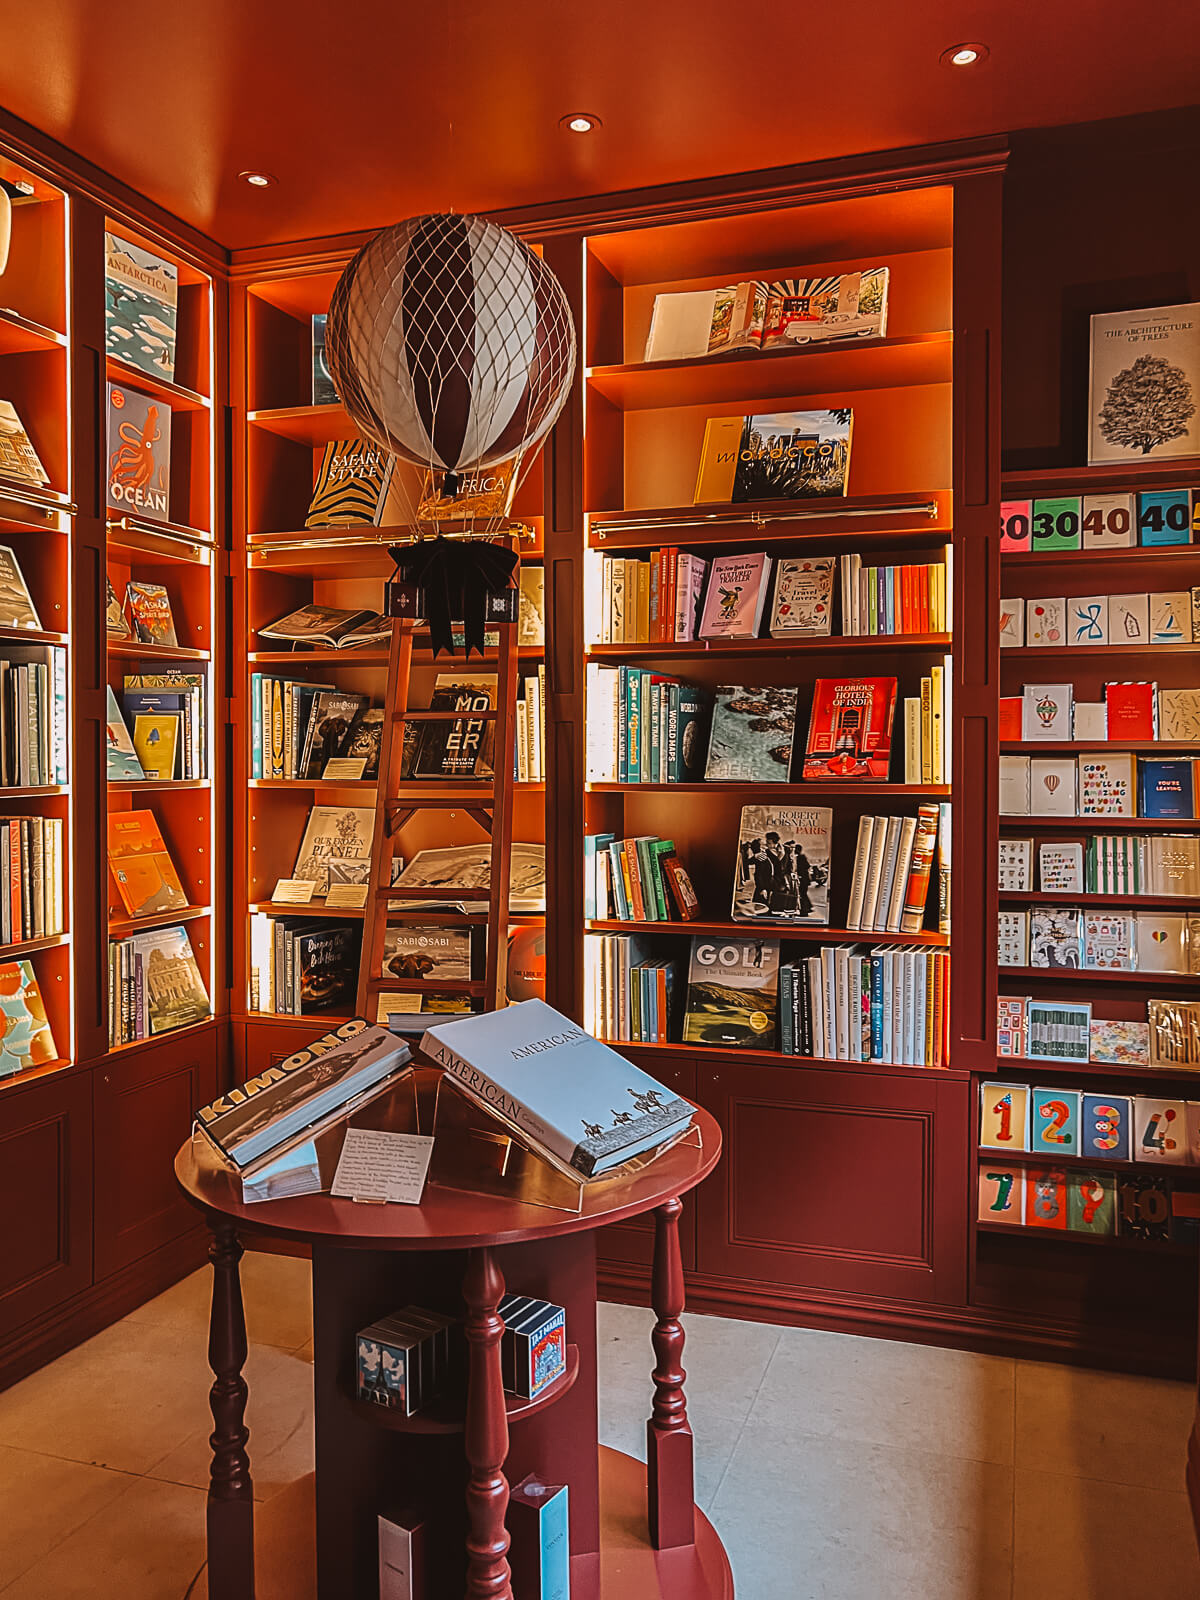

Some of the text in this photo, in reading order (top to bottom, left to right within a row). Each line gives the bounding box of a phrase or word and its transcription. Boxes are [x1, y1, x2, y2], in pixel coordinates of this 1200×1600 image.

[106, 258, 168, 294] ANTARCTICA
[1104, 322, 1193, 338] THE ARCHITECTURE
[1127, 331, 1169, 343] OF TREES
[330, 451, 380, 468] SAFARI
[327, 467, 377, 481] STYLE
[110, 481, 166, 513] OCEAN
[1034, 510, 1079, 539] 30
[1083, 507, 1130, 536] 40
[1140, 503, 1189, 532] 40
[834, 684, 875, 692] GLORIOUS
[835, 691, 873, 699] HOTELS
[455, 697, 489, 712] MO
[832, 698, 873, 707] OF INDIA
[29, 692, 37, 733] ITALY
[446, 733, 480, 750] ER
[669, 709, 677, 762] WORLD MAPS
[766, 818, 819, 827] DOISNEAU
[778, 811, 821, 820] ROBERT
[795, 826, 828, 835] PARIS
[314, 837, 365, 846] OUR FROZEN
[912, 817, 934, 870] London
[312, 845, 363, 858] PLANET
[33, 836, 41, 888] VENICE
[397, 937, 449, 947] SABI SABI
[696, 943, 773, 969] GOLF
[704, 968, 763, 978] The Ultimate Book
[510, 1027, 583, 1060] AMERICAN
[198, 1018, 368, 1123] KIMONO
[435, 1046, 523, 1119] AMERICAN
[531, 1313, 564, 1348] TAJ MAHAL
